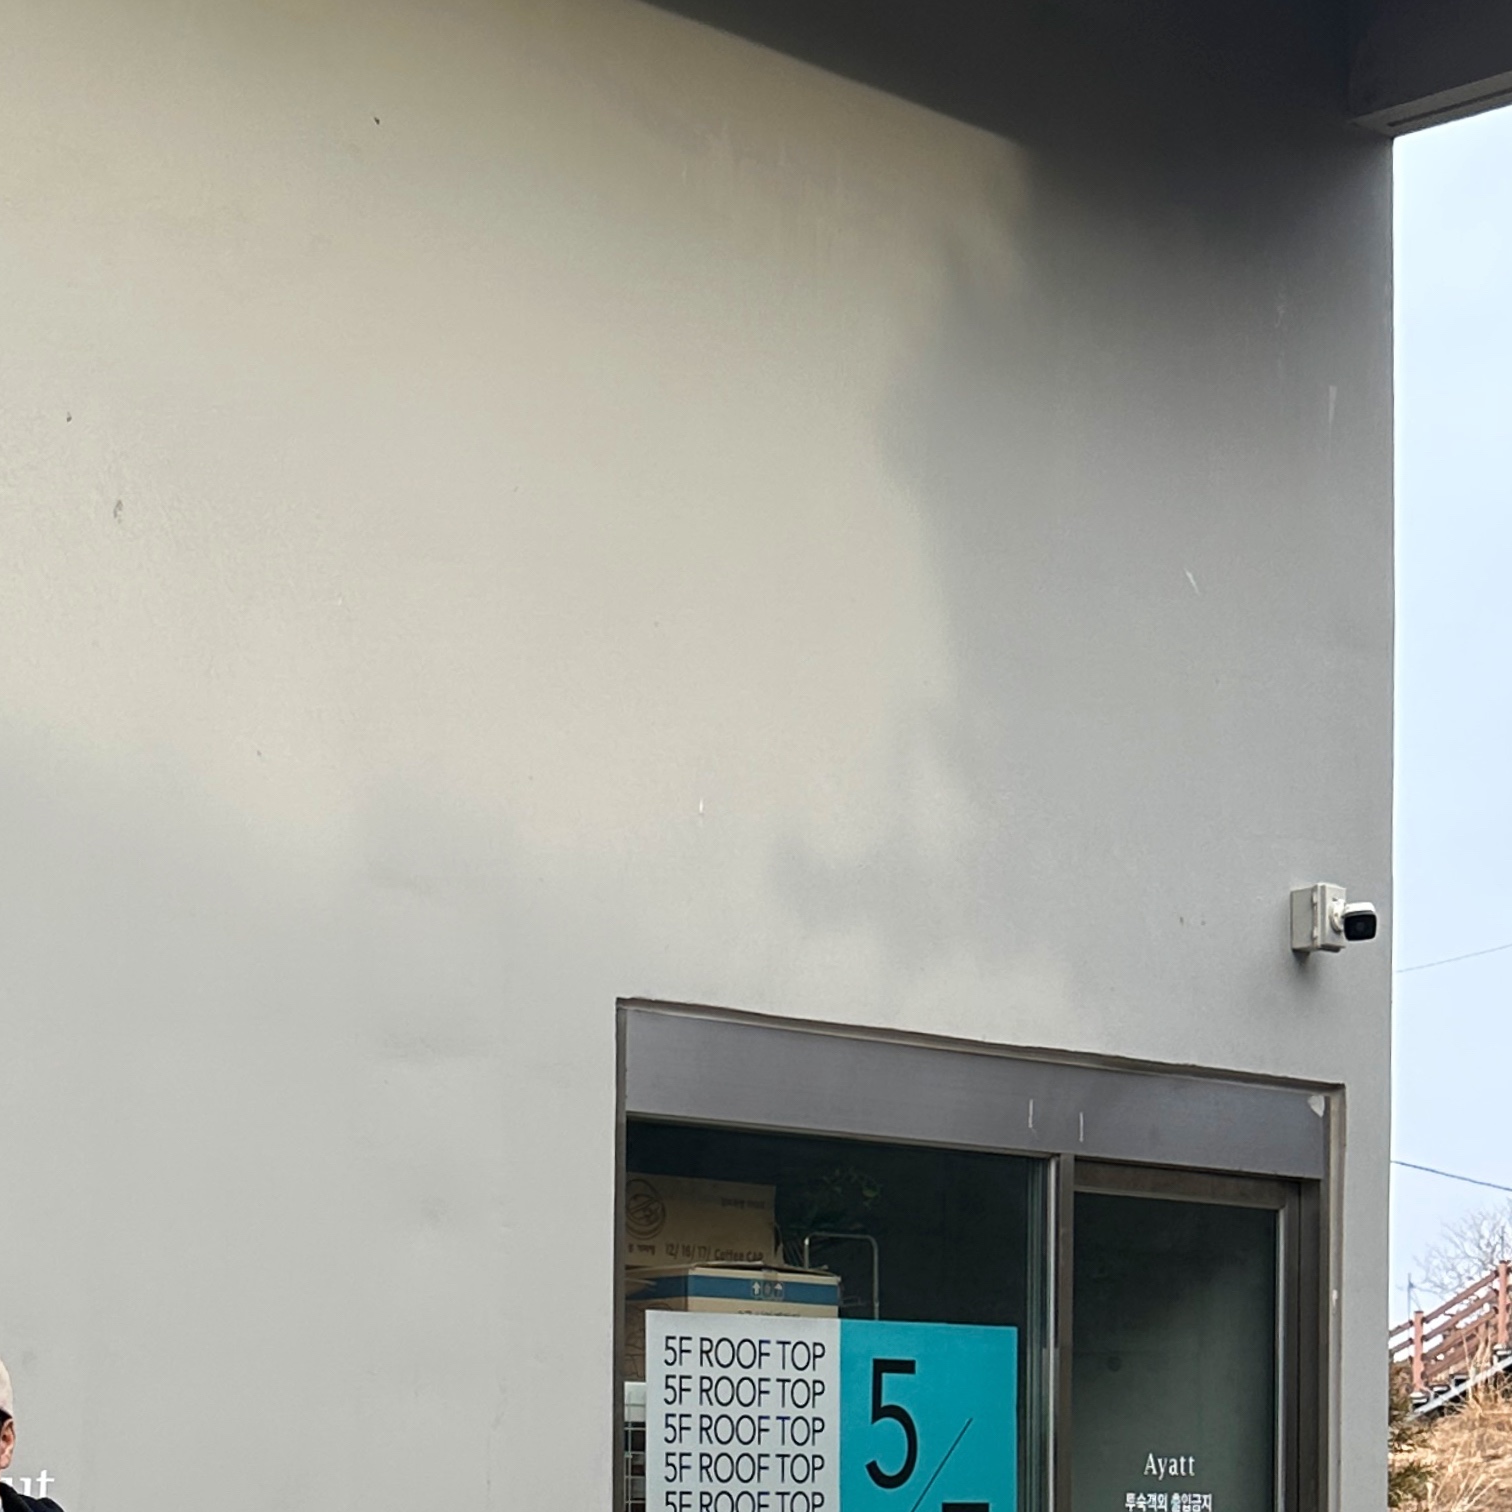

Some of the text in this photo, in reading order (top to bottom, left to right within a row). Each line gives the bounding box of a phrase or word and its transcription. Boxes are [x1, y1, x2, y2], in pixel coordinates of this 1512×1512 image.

[663, 1335, 693, 1367] 5F
[663, 1374, 693, 1406] 5F
[663, 1412, 692, 1444] 5F
[664, 1451, 693, 1483] 5F
[1143, 1453, 1195, 1480] Ayatt
[1170, 1493, 1213, 1512] 출입금지
